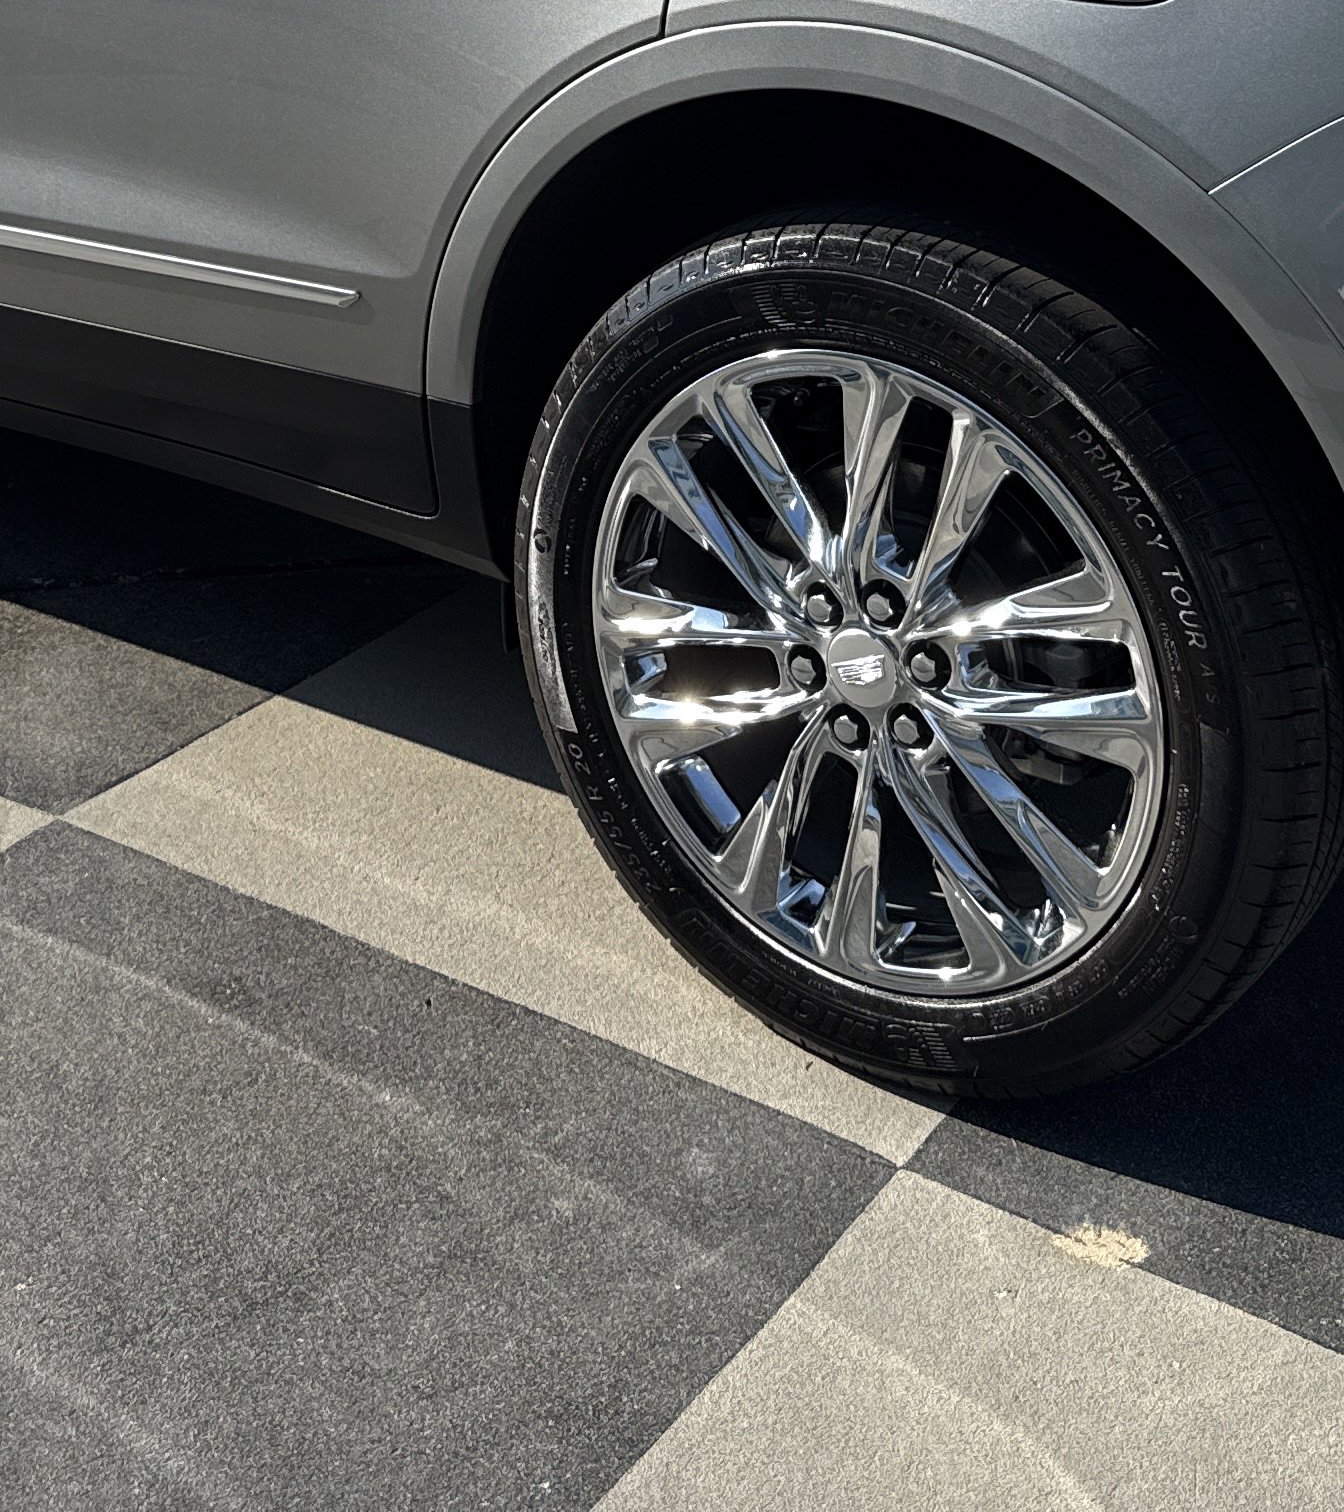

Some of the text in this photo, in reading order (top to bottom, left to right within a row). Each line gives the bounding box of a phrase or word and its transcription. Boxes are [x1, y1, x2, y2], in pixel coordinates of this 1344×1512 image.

[1070, 428, 1169, 551] PRIMACY
[1161, 565, 1207, 650] TOUR
[567, 742, 592, 776] 20
